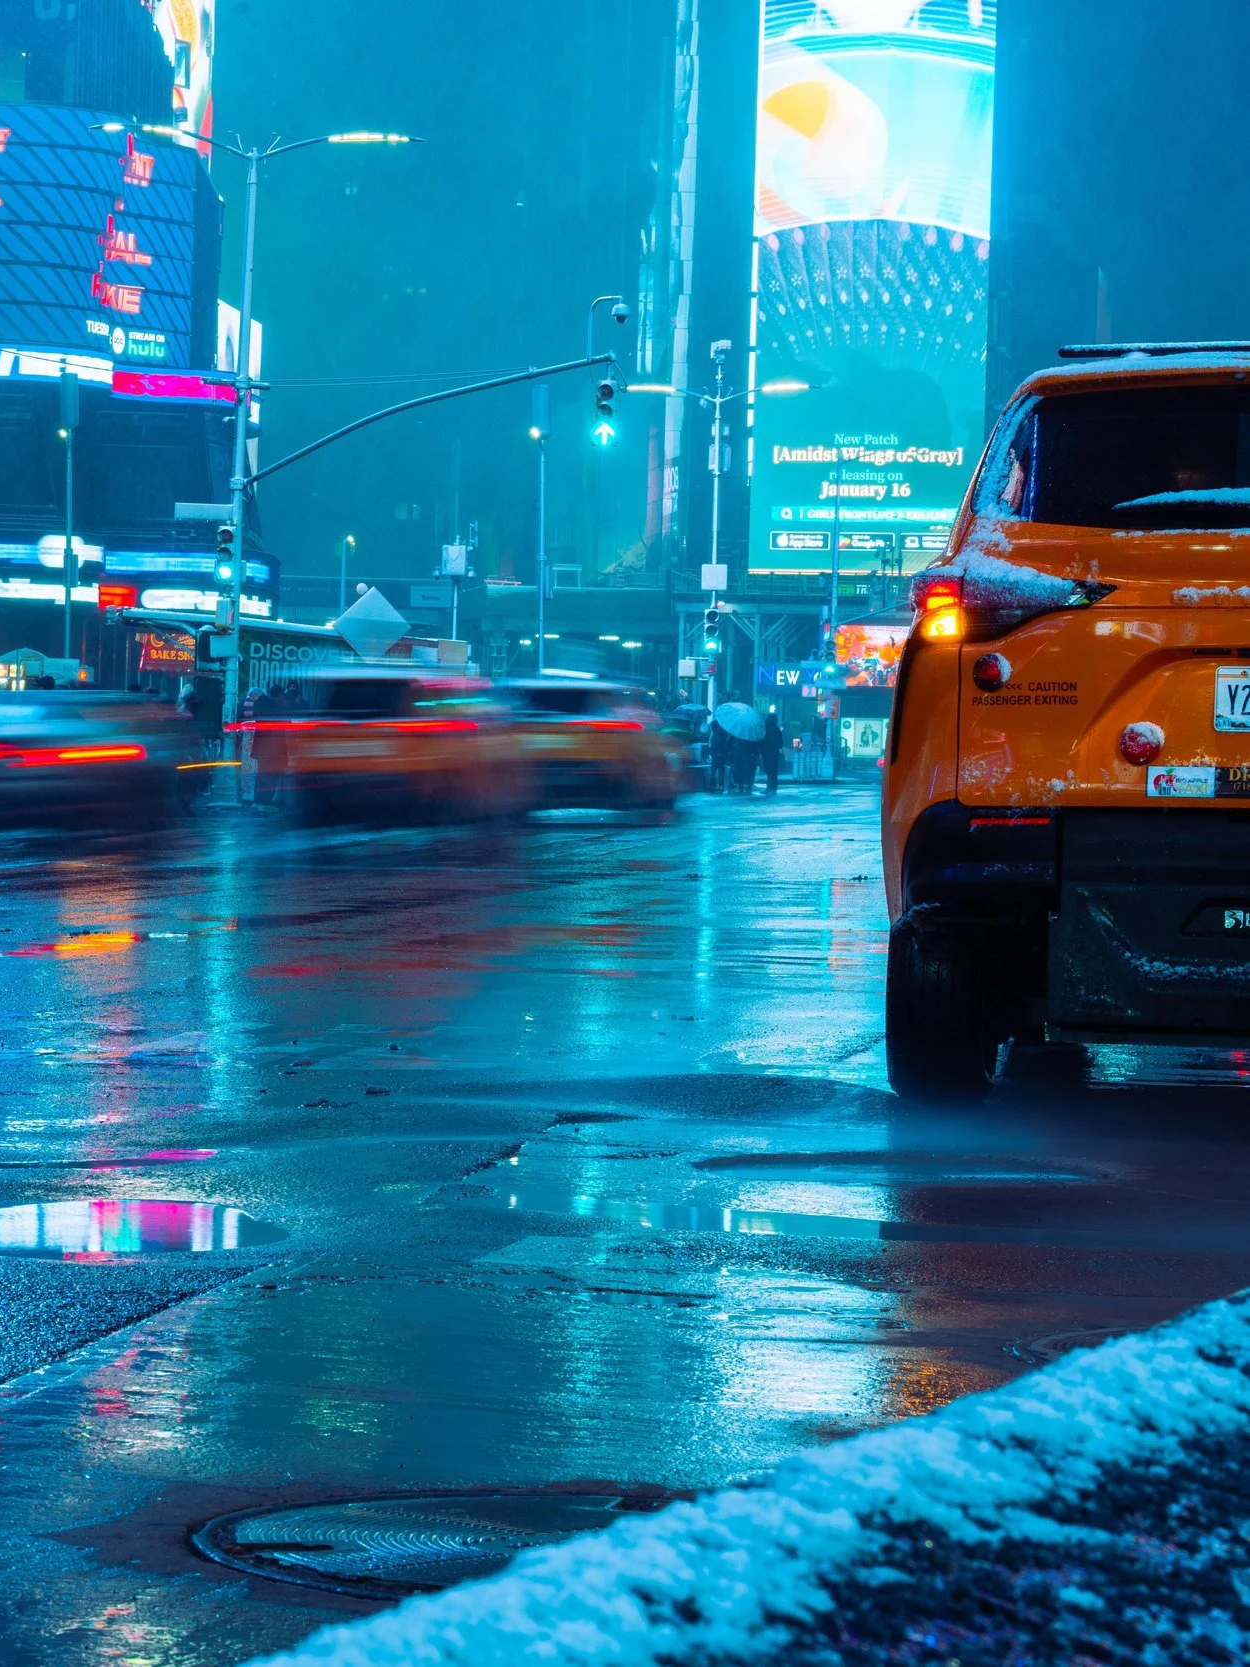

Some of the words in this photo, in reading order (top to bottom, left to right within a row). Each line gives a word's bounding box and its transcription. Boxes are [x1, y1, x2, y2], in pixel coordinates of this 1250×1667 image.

[128, 331, 155, 341] STREAM
[128, 341, 165, 357] hulu
[834, 434, 861, 445] New
[864, 434, 898, 445] Patch
[773, 445, 838, 464] [Amidst
[840, 446, 894, 466] Wings
[896, 447, 917, 463] of
[917, 447, 962, 467] Gray]
[887, 472, 903, 480] on
[819, 482, 887, 500] January
[891, 483, 911, 497] 16
[150, 649, 176, 660] BAKE
[758, 663, 800, 686] NEW
[1027, 681, 1078, 692] CAUTION
[972, 695, 1032, 706] PASSENGER
[1034, 695, 1079, 705] EXITING
[1177, 784, 1209, 795] TAXI
